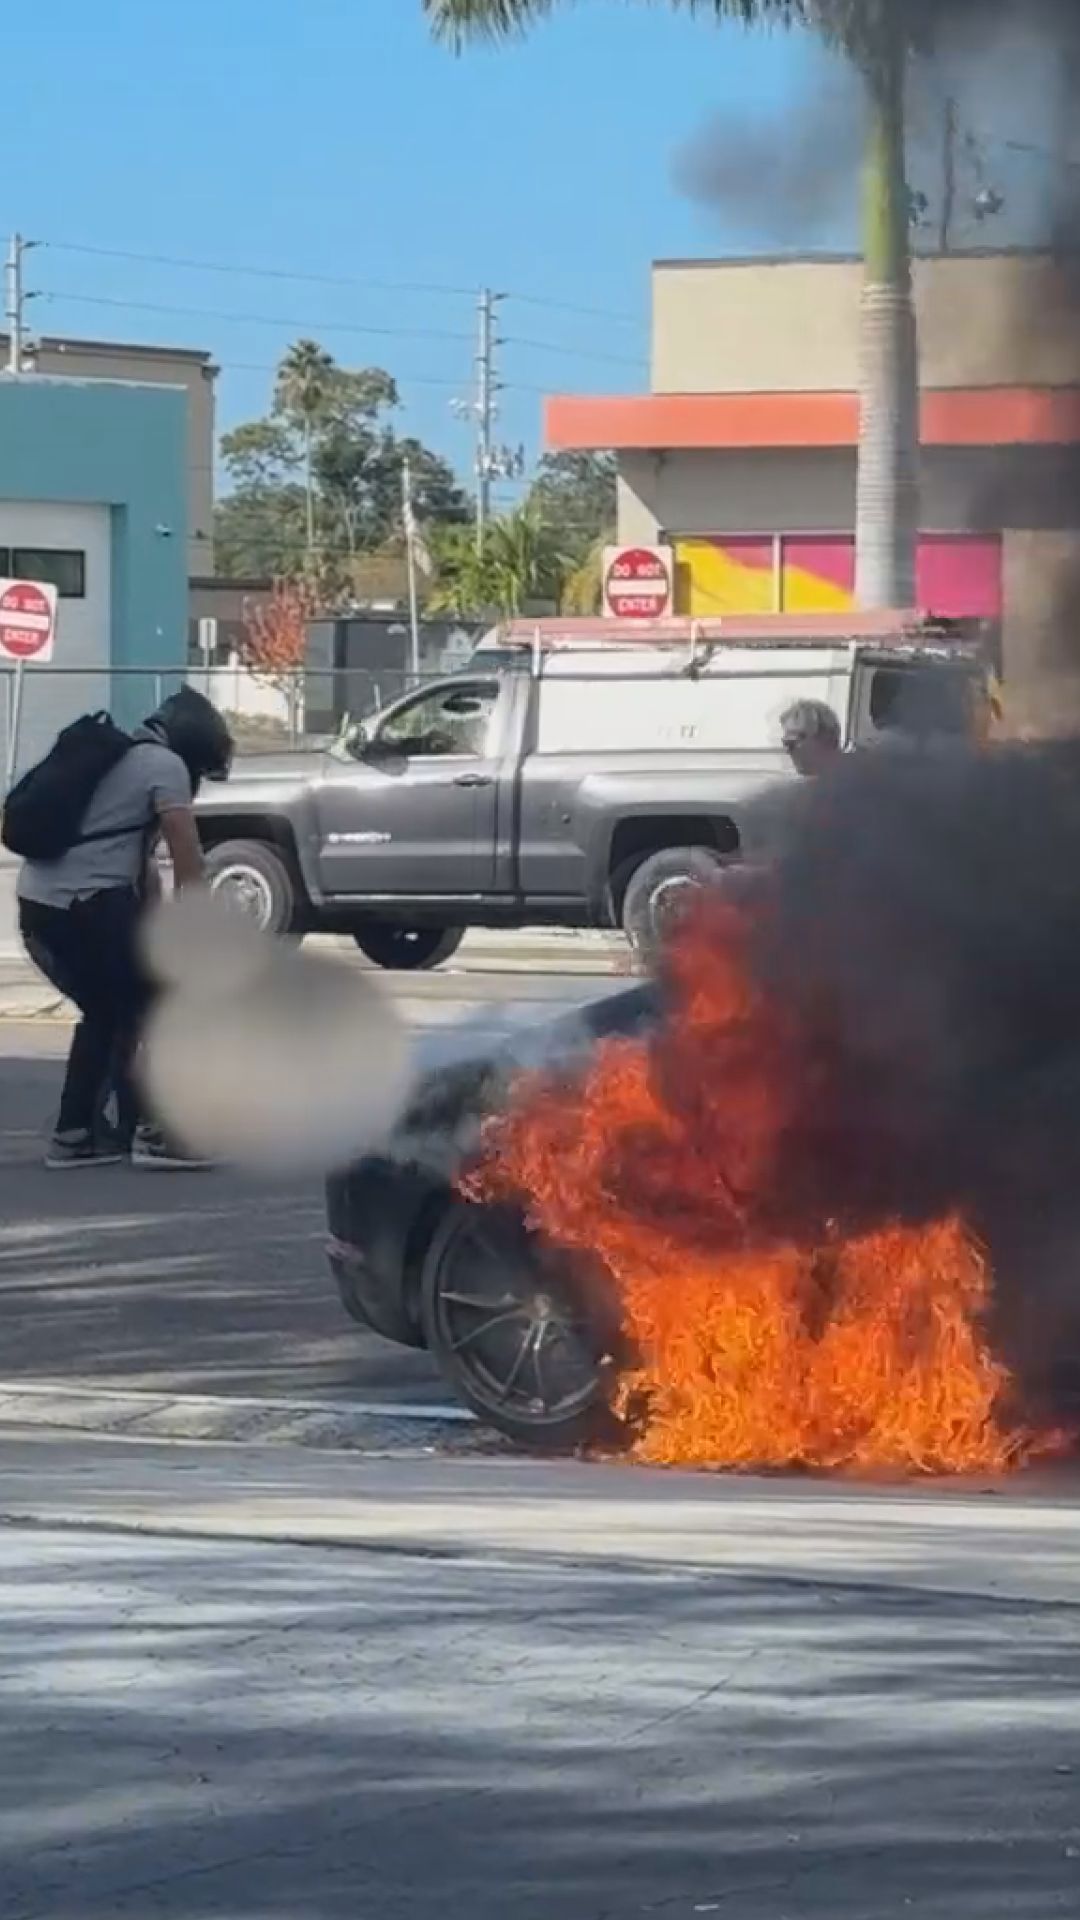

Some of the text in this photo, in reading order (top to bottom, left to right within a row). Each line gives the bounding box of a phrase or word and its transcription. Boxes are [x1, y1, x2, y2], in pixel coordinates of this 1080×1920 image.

[613, 563, 660, 577] DO NOT
[2, 594, 44, 612] DO NOT
[618, 598, 656, 612] ENTER
[4, 628, 40, 644] ENTER
